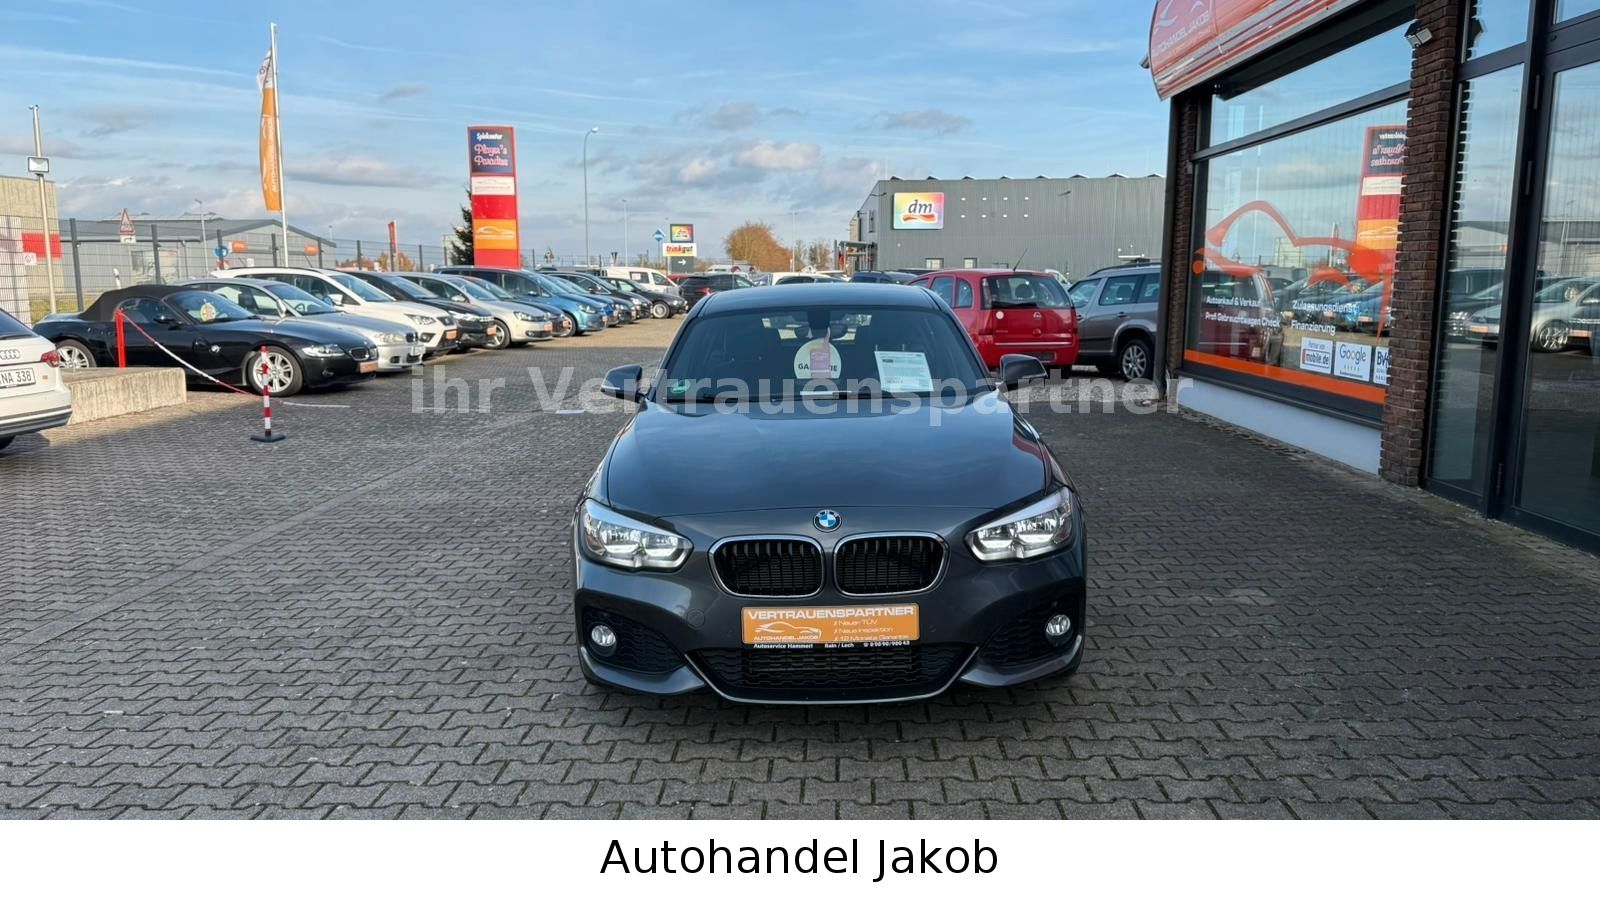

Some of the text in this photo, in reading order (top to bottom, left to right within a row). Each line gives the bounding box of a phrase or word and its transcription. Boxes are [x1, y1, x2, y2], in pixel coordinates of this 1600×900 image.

[908, 199, 933, 213] dm
[666, 244, 693, 254] trinkgut
[1291, 319, 1336, 336] Finanzierung
[1305, 352, 1330, 366] mobile.de
[1340, 343, 1367, 365] Google
[798, 362, 838, 372] GAIE
[15, 370, 32, 383] 338
[748, 606, 914, 620] VERTRAUENSPARTNER
[862, 617, 878, 626] TÜV
